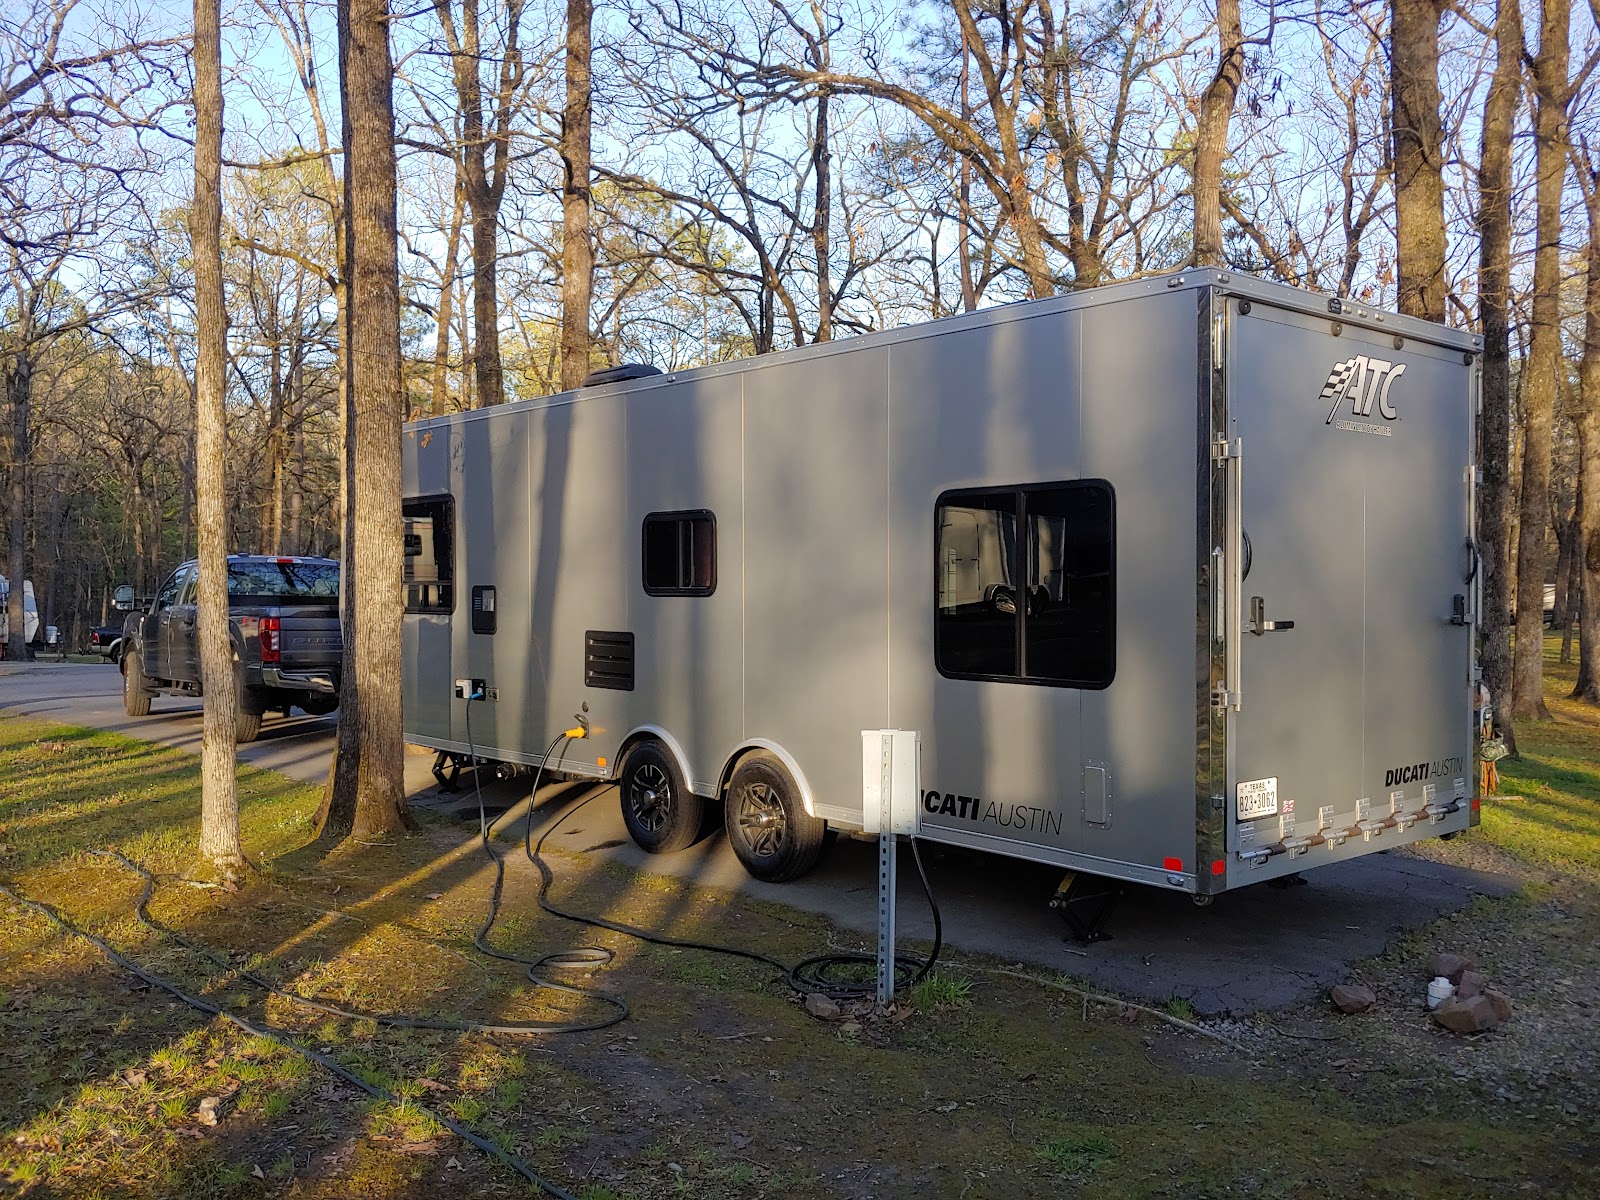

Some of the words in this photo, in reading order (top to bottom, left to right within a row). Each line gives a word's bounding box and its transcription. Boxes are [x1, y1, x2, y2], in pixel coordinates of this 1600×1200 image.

[1326, 353, 1407, 424] ATC
[1249, 781, 1266, 790] TEXAS
[1385, 762, 1430, 787] DUCATI
[1430, 757, 1464, 778] AUSTIN
[921, 789, 981, 821] CATI
[982, 801, 1063, 836] AUSTIN
